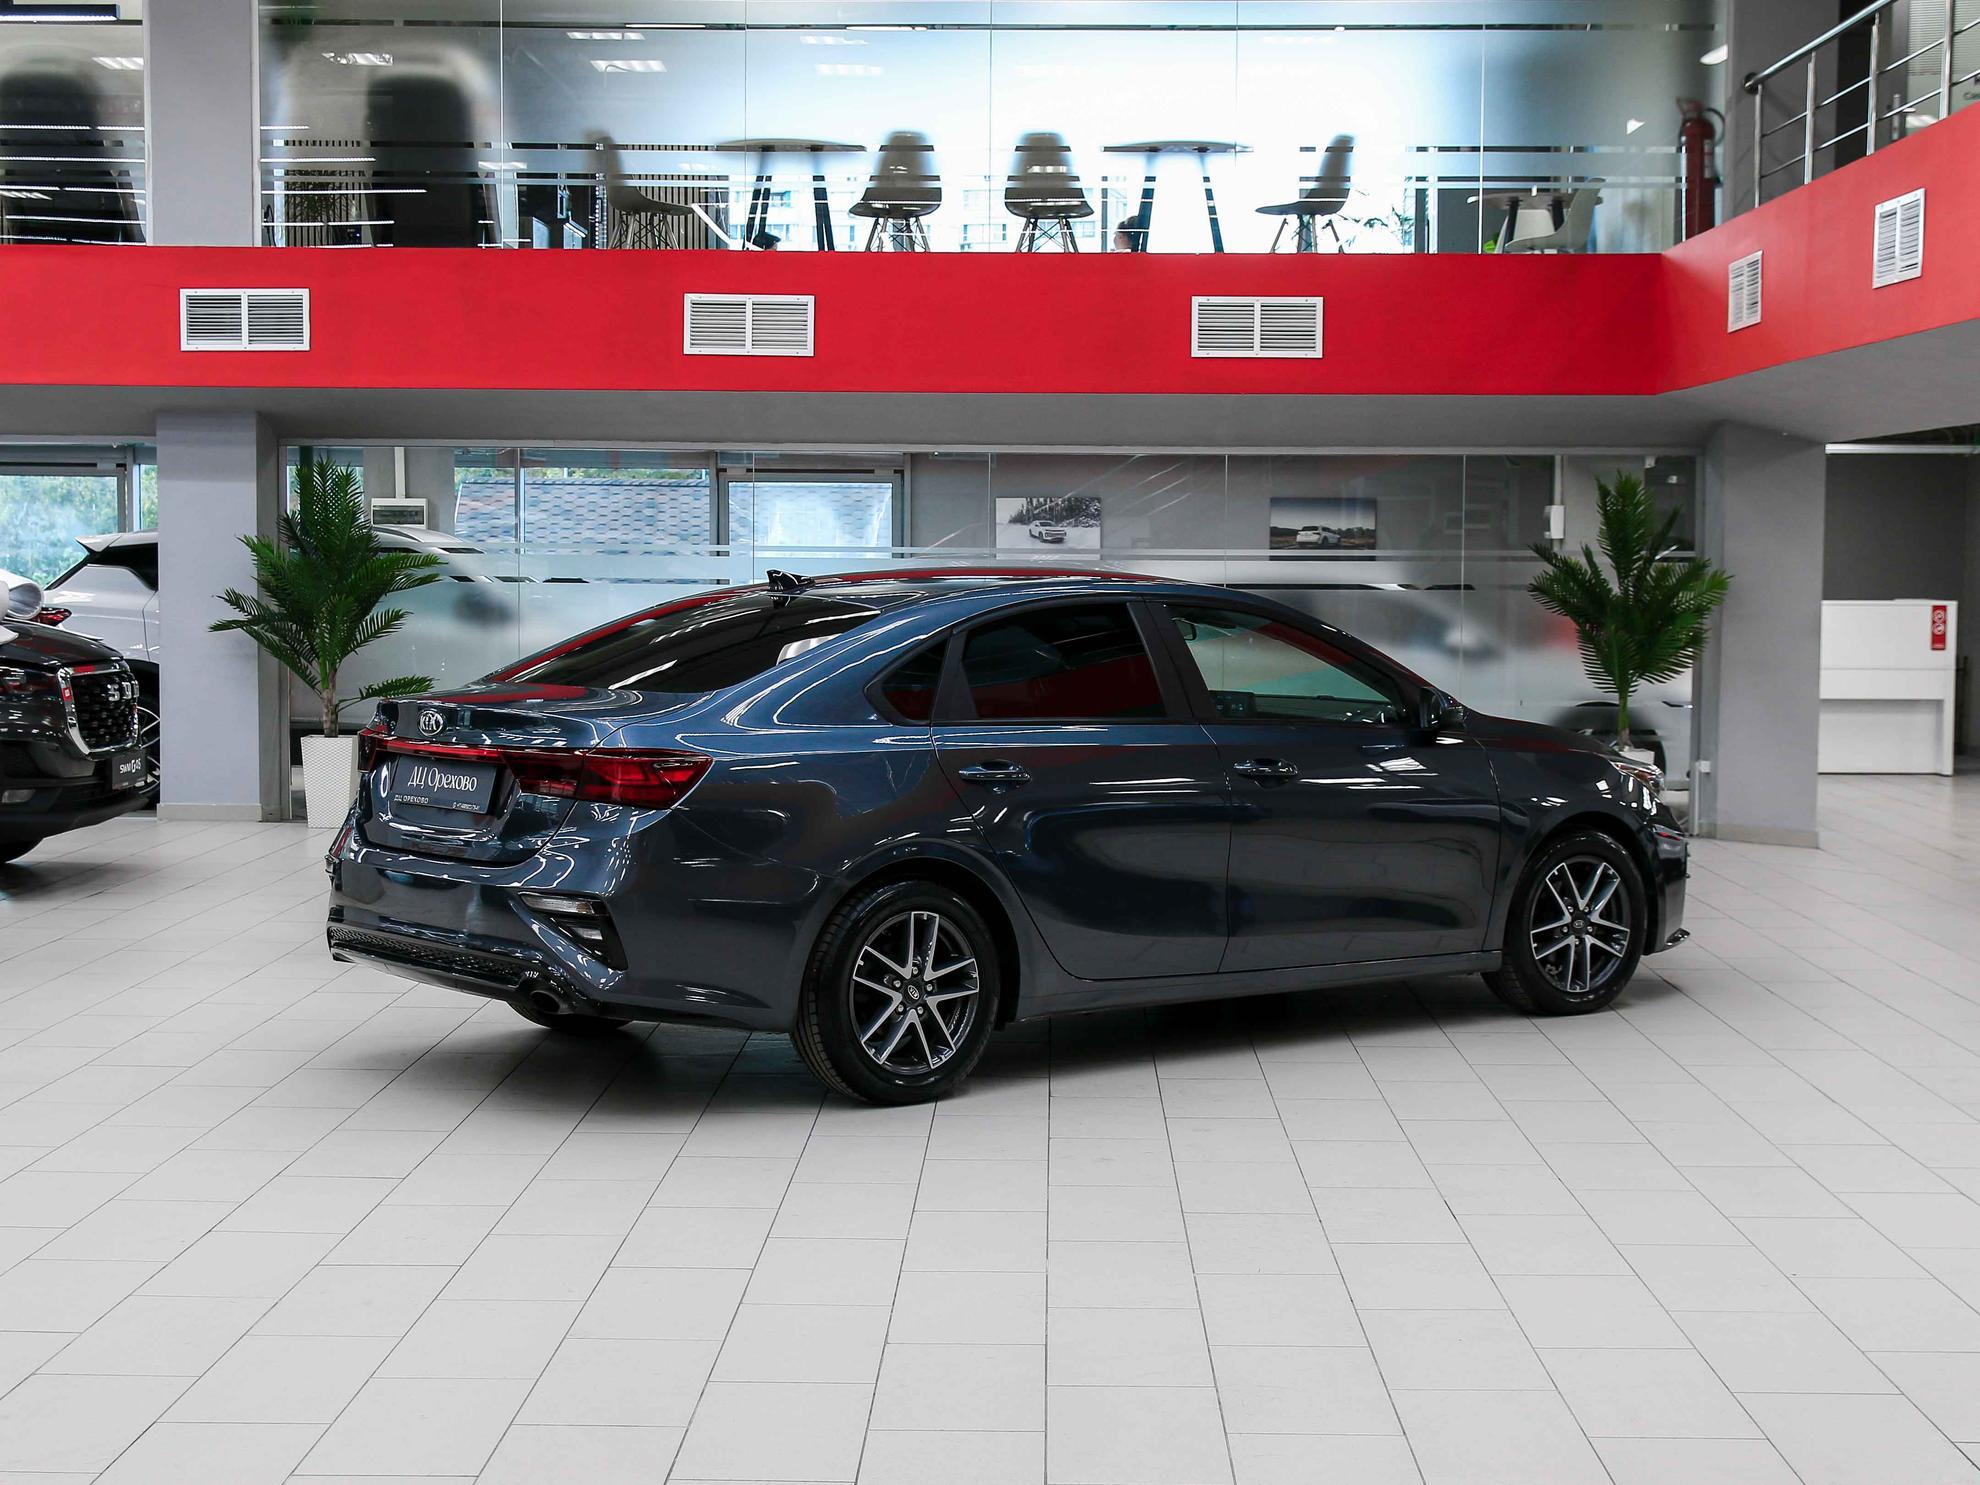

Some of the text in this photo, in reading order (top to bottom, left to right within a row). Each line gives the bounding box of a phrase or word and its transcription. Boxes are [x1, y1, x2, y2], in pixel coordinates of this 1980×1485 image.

[408, 766, 477, 792] ДЦ Орехово
[403, 795, 429, 804] ОРЕХОВО
